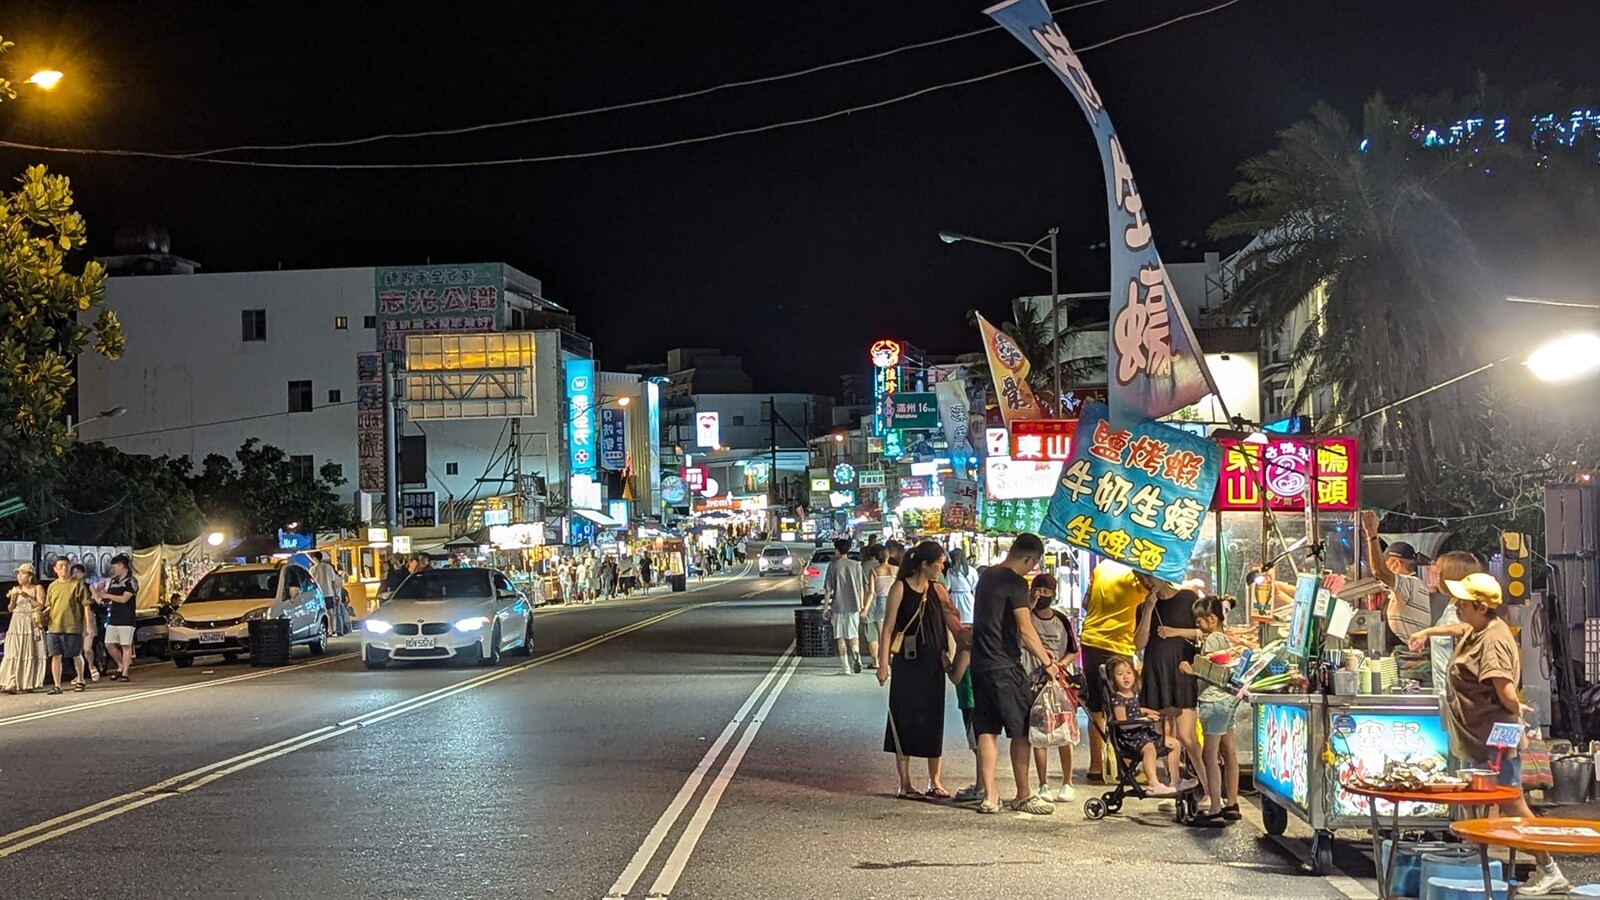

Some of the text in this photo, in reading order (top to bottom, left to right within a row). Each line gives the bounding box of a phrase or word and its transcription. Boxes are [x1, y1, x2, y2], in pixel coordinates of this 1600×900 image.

[378, 285, 498, 315] 志光公職
[896, 402, 916, 413] 滿州
[1016, 434, 1070, 459] 東山
[1089, 419, 1205, 490] 鹽烤蝦
[1225, 444, 1260, 505] 東山
[1316, 444, 1348, 505] 鴨頭
[1061, 460, 1205, 541] 牛奶生蠔
[1066, 514, 1167, 572] 生啤酒
